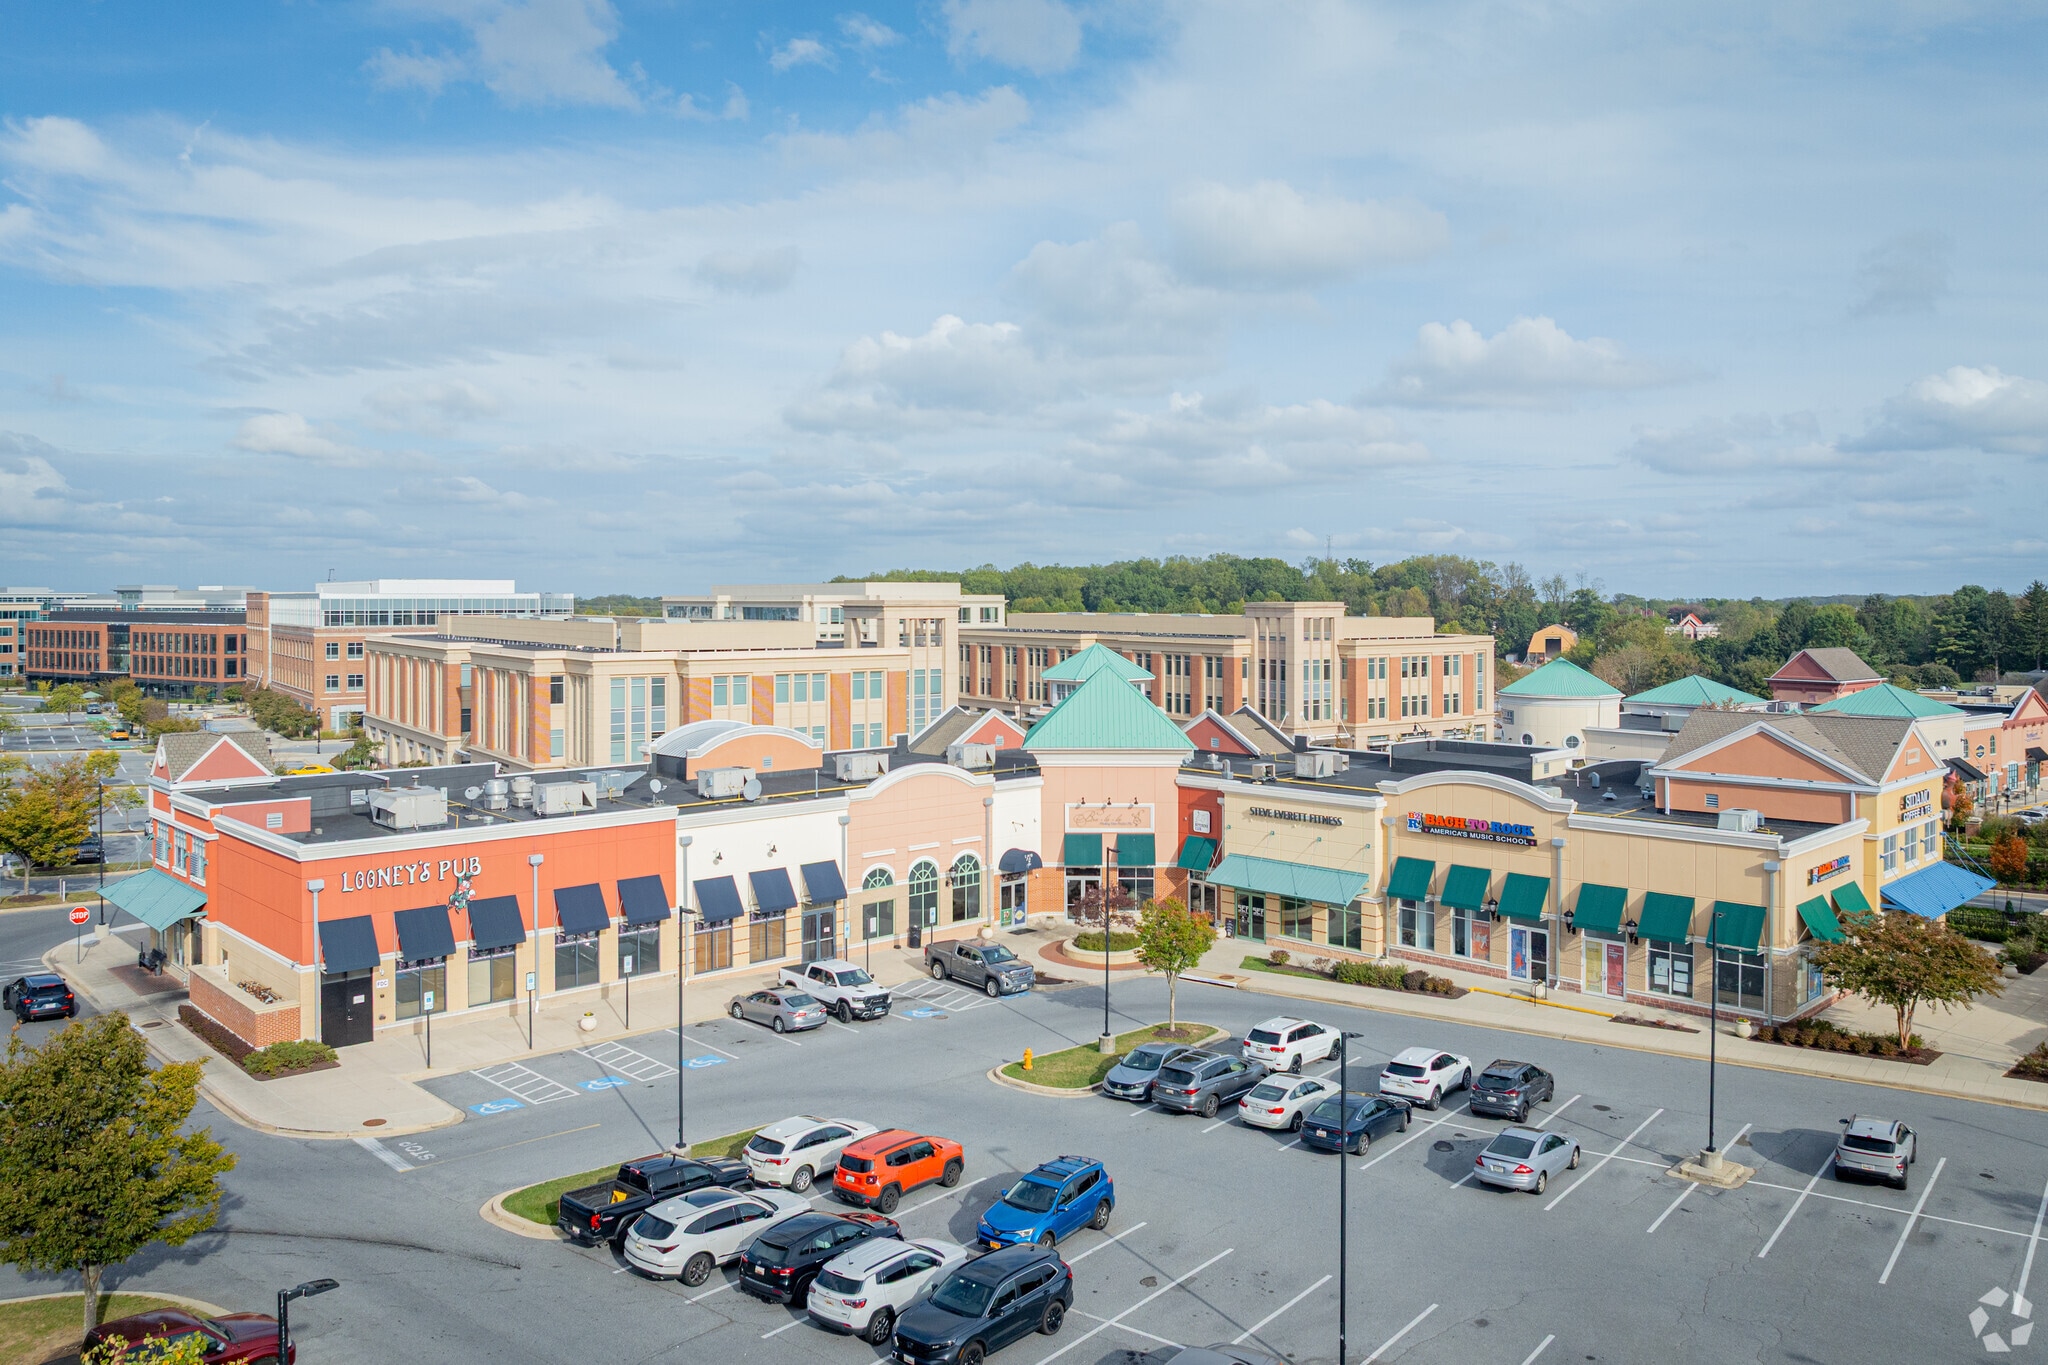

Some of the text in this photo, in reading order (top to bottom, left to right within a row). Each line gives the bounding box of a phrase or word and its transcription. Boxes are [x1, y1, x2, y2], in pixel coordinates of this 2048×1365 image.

[1249, 806, 1343, 827] STEVE EVERETT FITNESS
[1903, 808, 1921, 822] COFFEE
[1425, 813, 1535, 837] BACH TO ROCK
[1429, 827, 1529, 846] AMERICA'S MUSIC SCHOOL
[341, 856, 482, 892] LOONEY'S PUB
[71, 911, 88, 920] STOP
[399, 1141, 436, 1160] STOP
